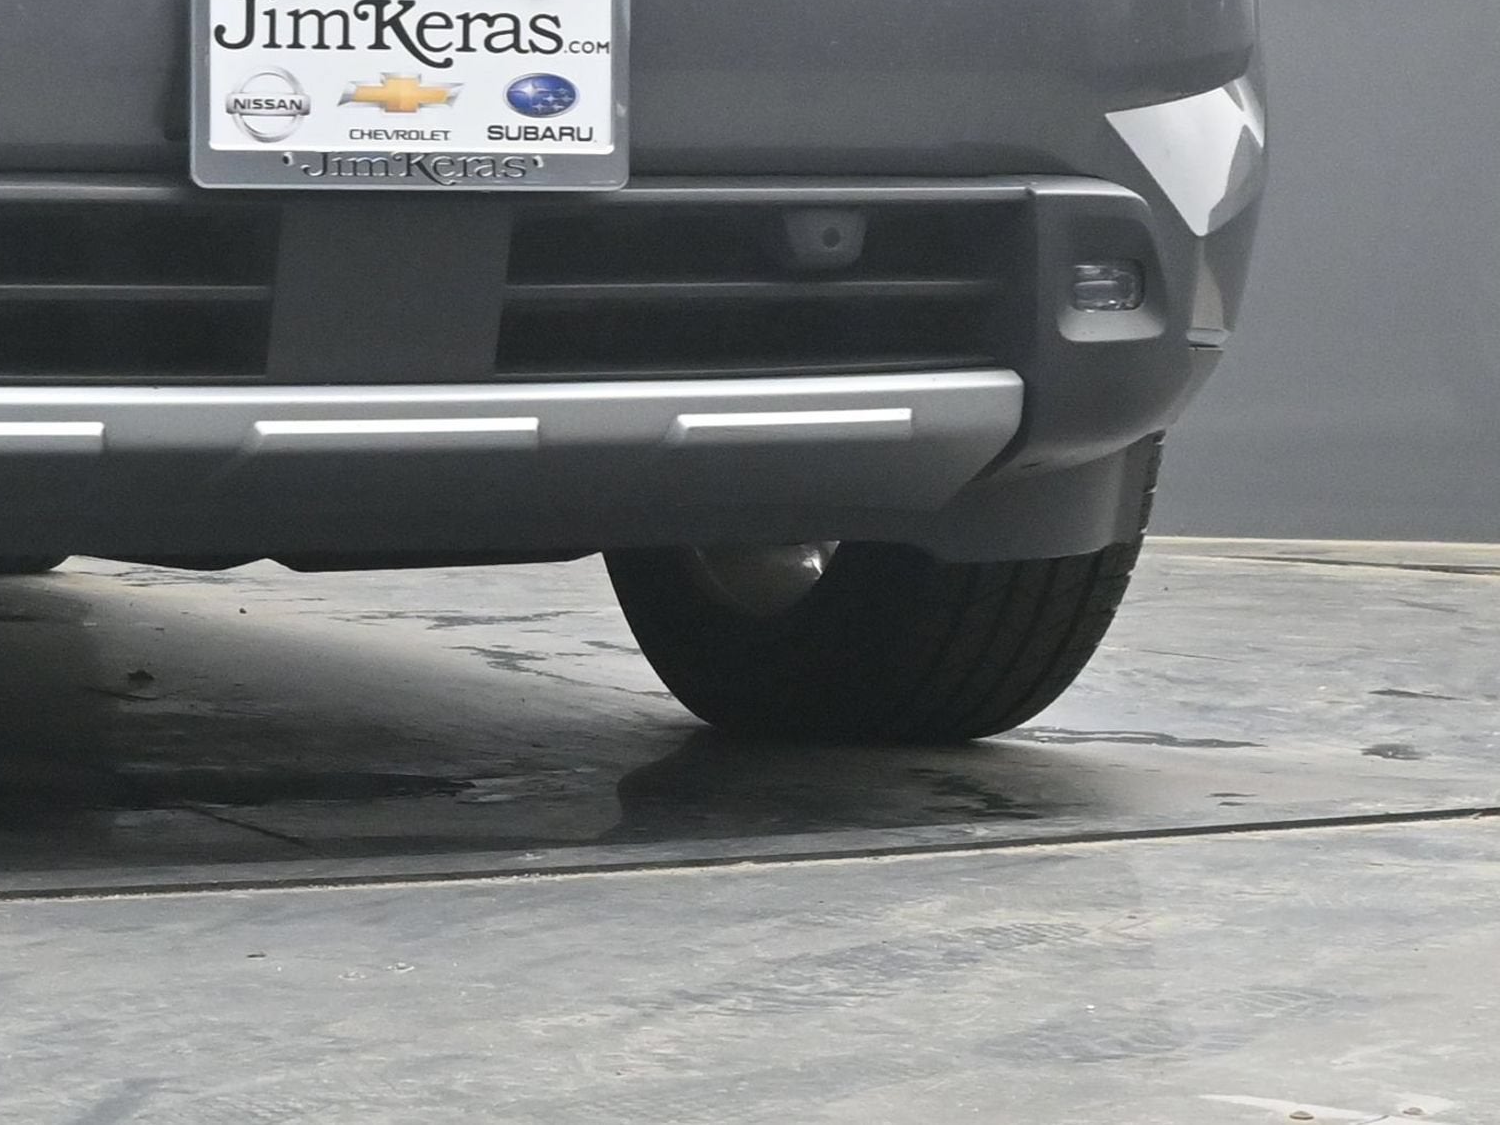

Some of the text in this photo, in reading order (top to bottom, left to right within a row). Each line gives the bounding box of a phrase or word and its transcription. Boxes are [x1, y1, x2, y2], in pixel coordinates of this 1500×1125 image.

[232, 97, 304, 111] NISSAN
[348, 128, 451, 142] CHEVROLET
[486, 125, 594, 142] SUBARU
